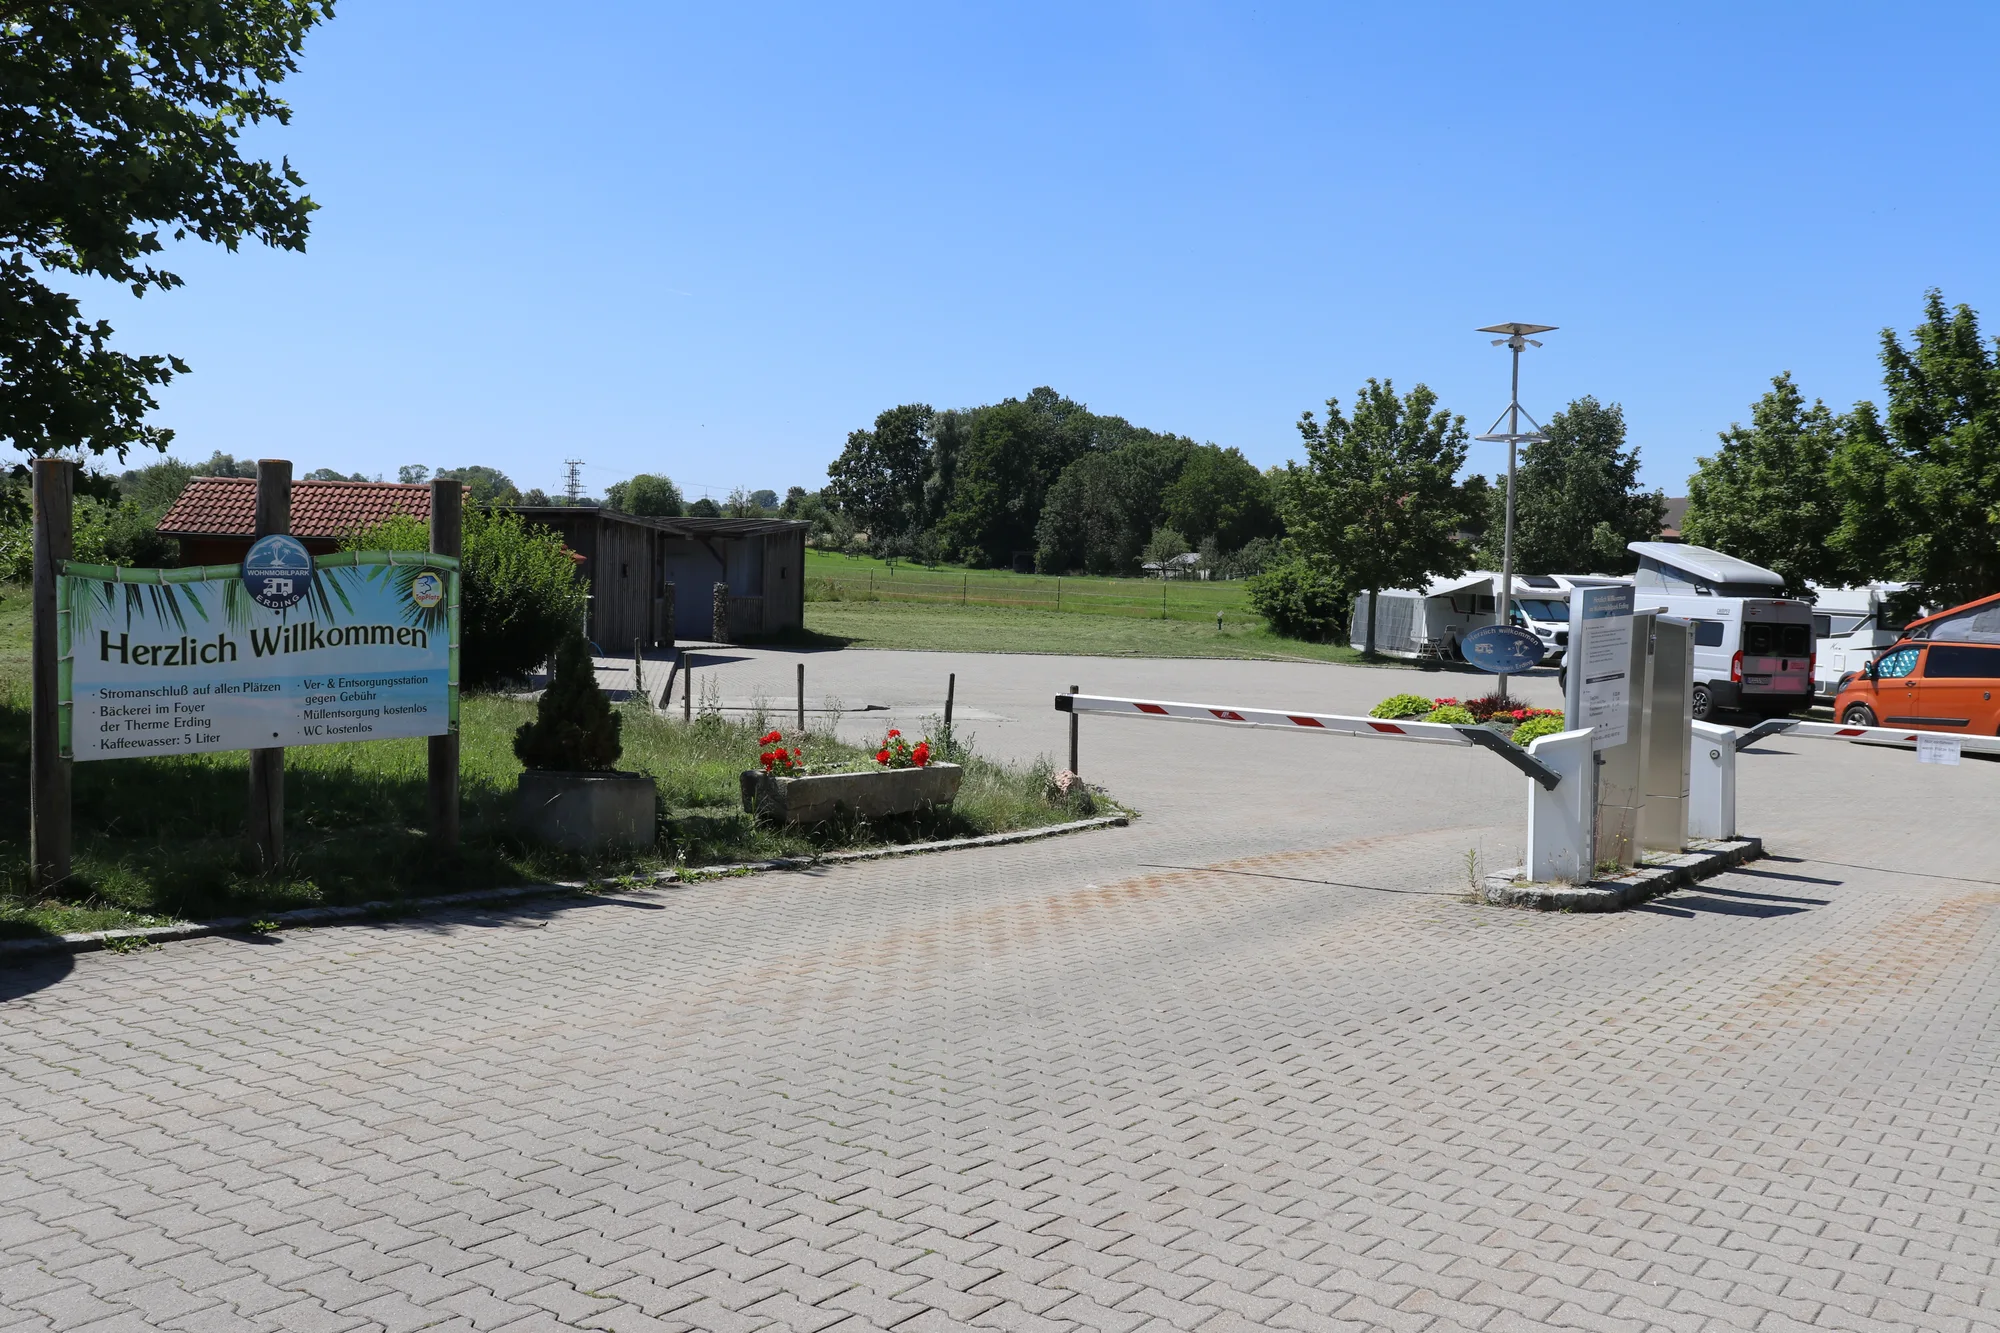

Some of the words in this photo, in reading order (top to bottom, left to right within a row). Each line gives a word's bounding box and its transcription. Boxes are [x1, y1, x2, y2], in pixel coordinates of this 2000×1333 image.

[256, 595, 300, 608] ERDING
[100, 630, 237, 666] Herzlich
[250, 621, 428, 658] Willkommen
[1468, 628, 1496, 642] Herzlich
[1498, 628, 1539, 646] willkommen
[1515, 660, 1534, 670] Erding
[100, 685, 189, 700] Stromanschluß
[193, 684, 210, 695] auf
[214, 683, 240, 695] allen
[243, 681, 281, 694] Plätzen
[304, 679, 325, 690] Ver-
[327, 678, 336, 689] &
[338, 676, 428, 689] Entsorgungsstation
[305, 693, 336, 706] gegen
[340, 690, 377, 702] Gebühr
[100, 704, 151, 717] Bäckerei
[156, 703, 170, 715] im
[174, 702, 206, 716] Foyer
[304, 707, 380, 721] Müllentsorgung
[384, 704, 428, 716] kostenlos
[100, 721, 121, 733] der
[125, 718, 170, 731] Therme
[174, 716, 212, 729] Erding
[304, 725, 323, 736] WC
[327, 722, 373, 735] kostenlos
[100, 736, 180, 750] Kaffeewasser:
[184, 734, 193, 745] 5
[196, 733, 221, 745] Liter
